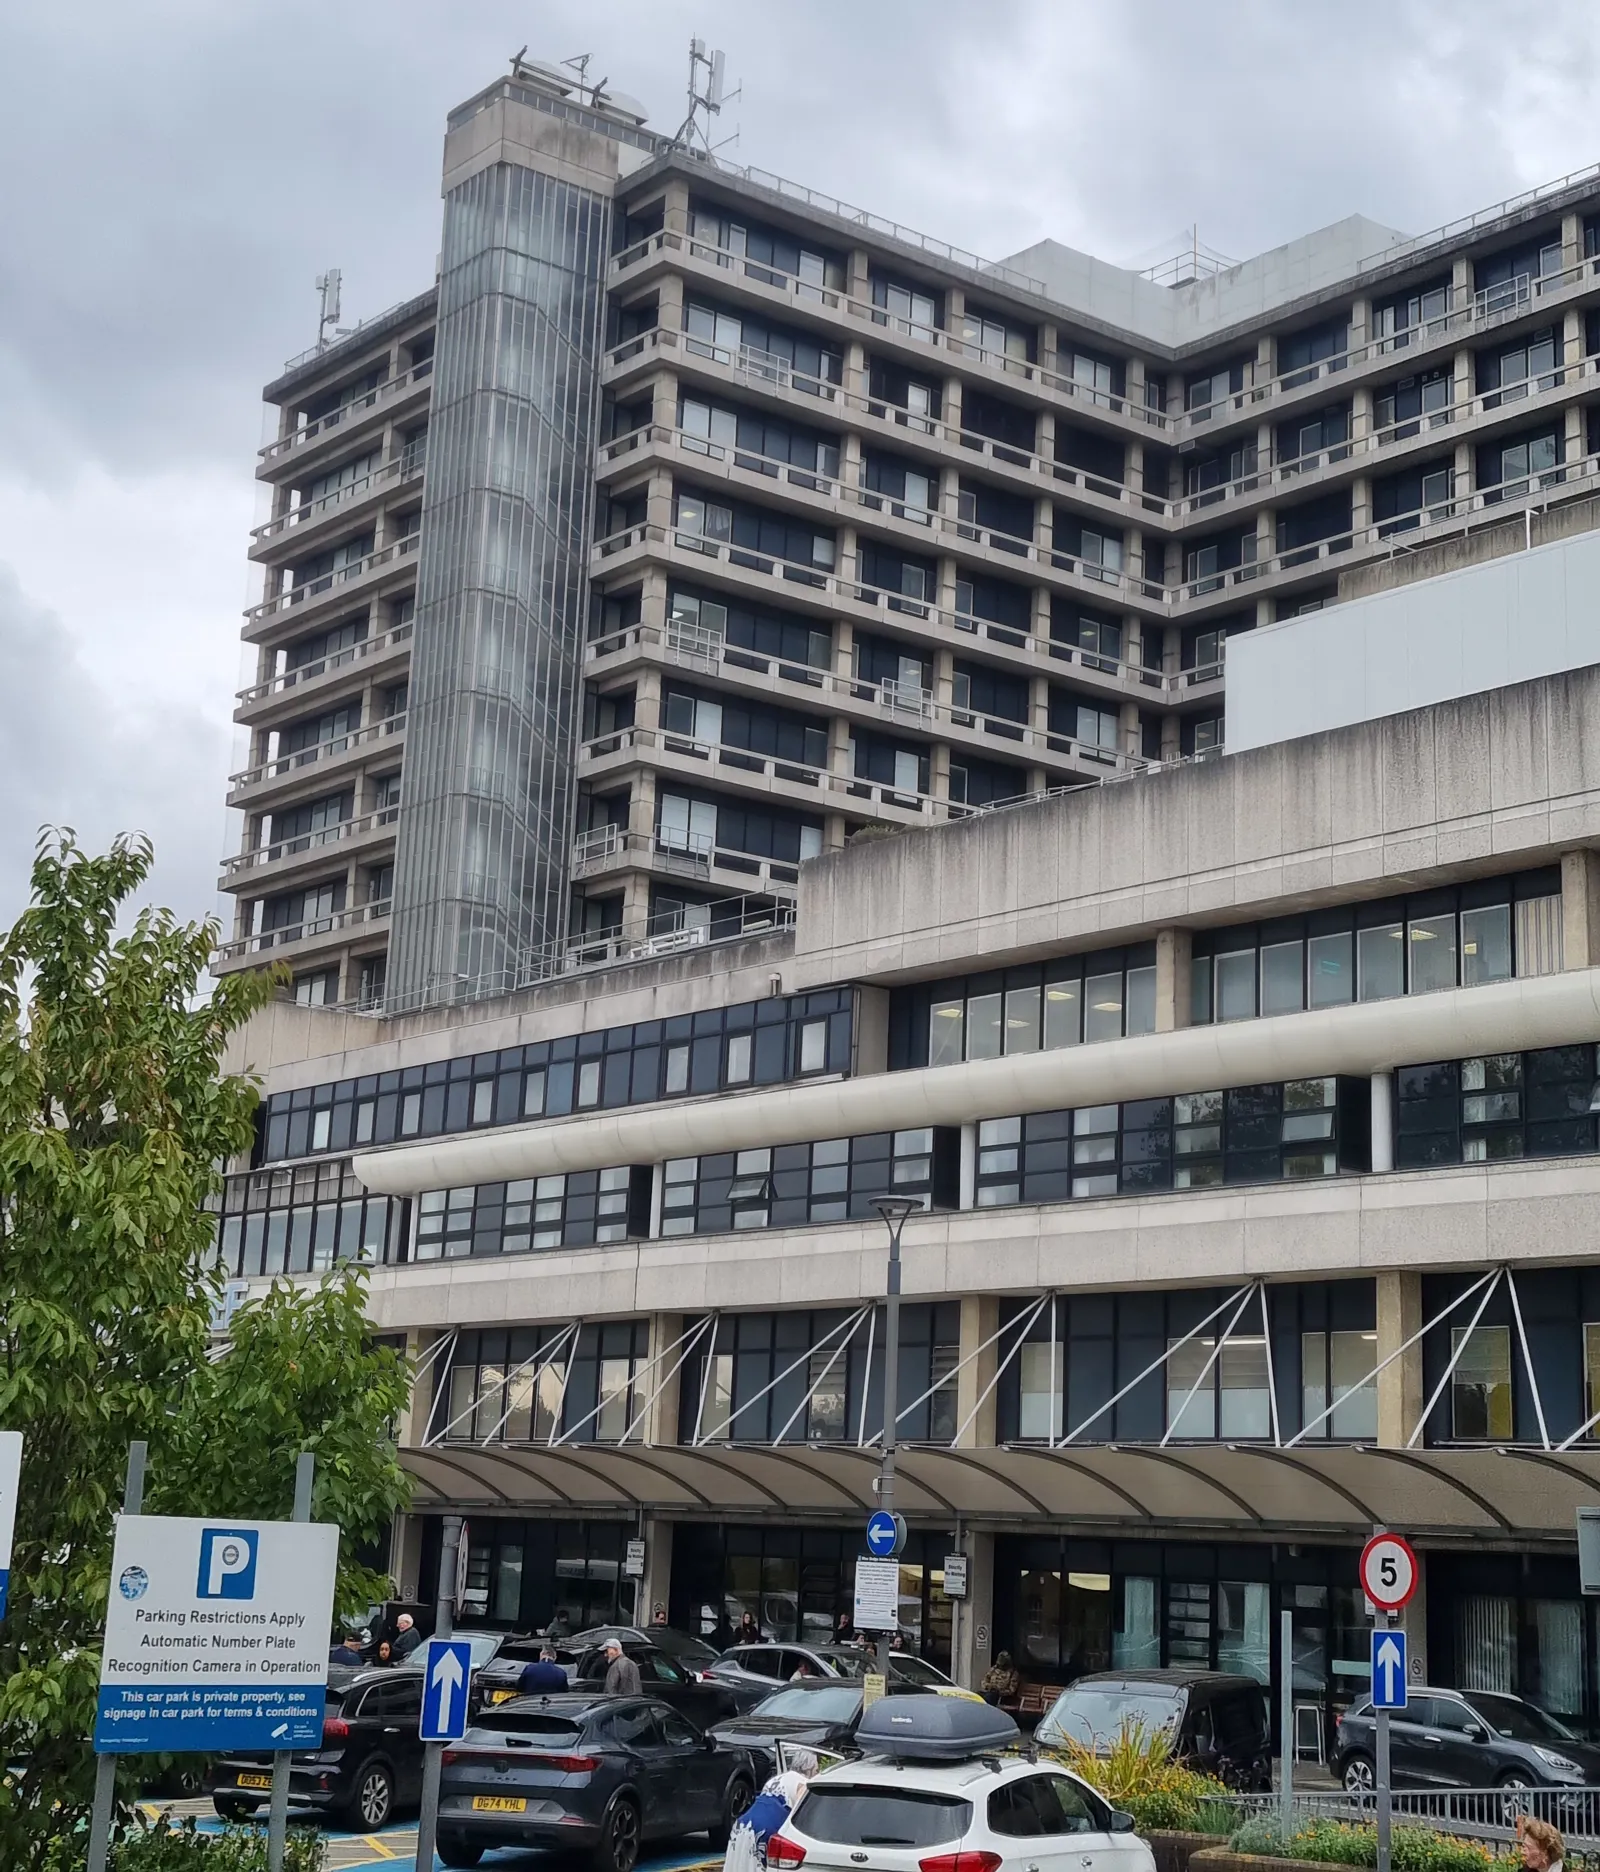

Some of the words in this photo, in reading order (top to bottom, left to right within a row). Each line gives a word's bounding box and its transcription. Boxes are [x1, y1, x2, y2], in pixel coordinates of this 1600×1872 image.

[207, 1535, 250, 1595] P
[1380, 1557, 1397, 1587] 5
[135, 1608, 186, 1626] Parking
[190, 1610, 267, 1624] Restrictions
[269, 1611, 306, 1627] Apply
[140, 1634, 208, 1648] Automatic
[211, 1635, 262, 1648] Number
[265, 1636, 297, 1649] Plate
[107, 1658, 188, 1675] Recognition
[192, 1659, 242, 1673] Camera
[245, 1659, 257, 1672] in
[260, 1659, 321, 1675] Operation
[121, 1691, 144, 1702] This
[146, 1693, 165, 1702] car
[166, 1691, 189, 1704] park
[192, 1691, 201, 1702] is
[203, 1691, 238, 1704] private
[241, 1692, 286, 1704] property,
[288, 1692, 306, 1701] see
[103, 1707, 146, 1721] signage
[149, 1706, 159, 1718] in
[161, 1708, 178, 1718] car
[181, 1706, 204, 1720] park
[207, 1706, 221, 1718] for
[224, 1707, 253, 1717] terms
[255, 1706, 263, 1717] &
[265, 1705, 318, 1717] conditions
[477, 1797, 501, 1808] DG74
[504, 1798, 521, 1809] YHL
